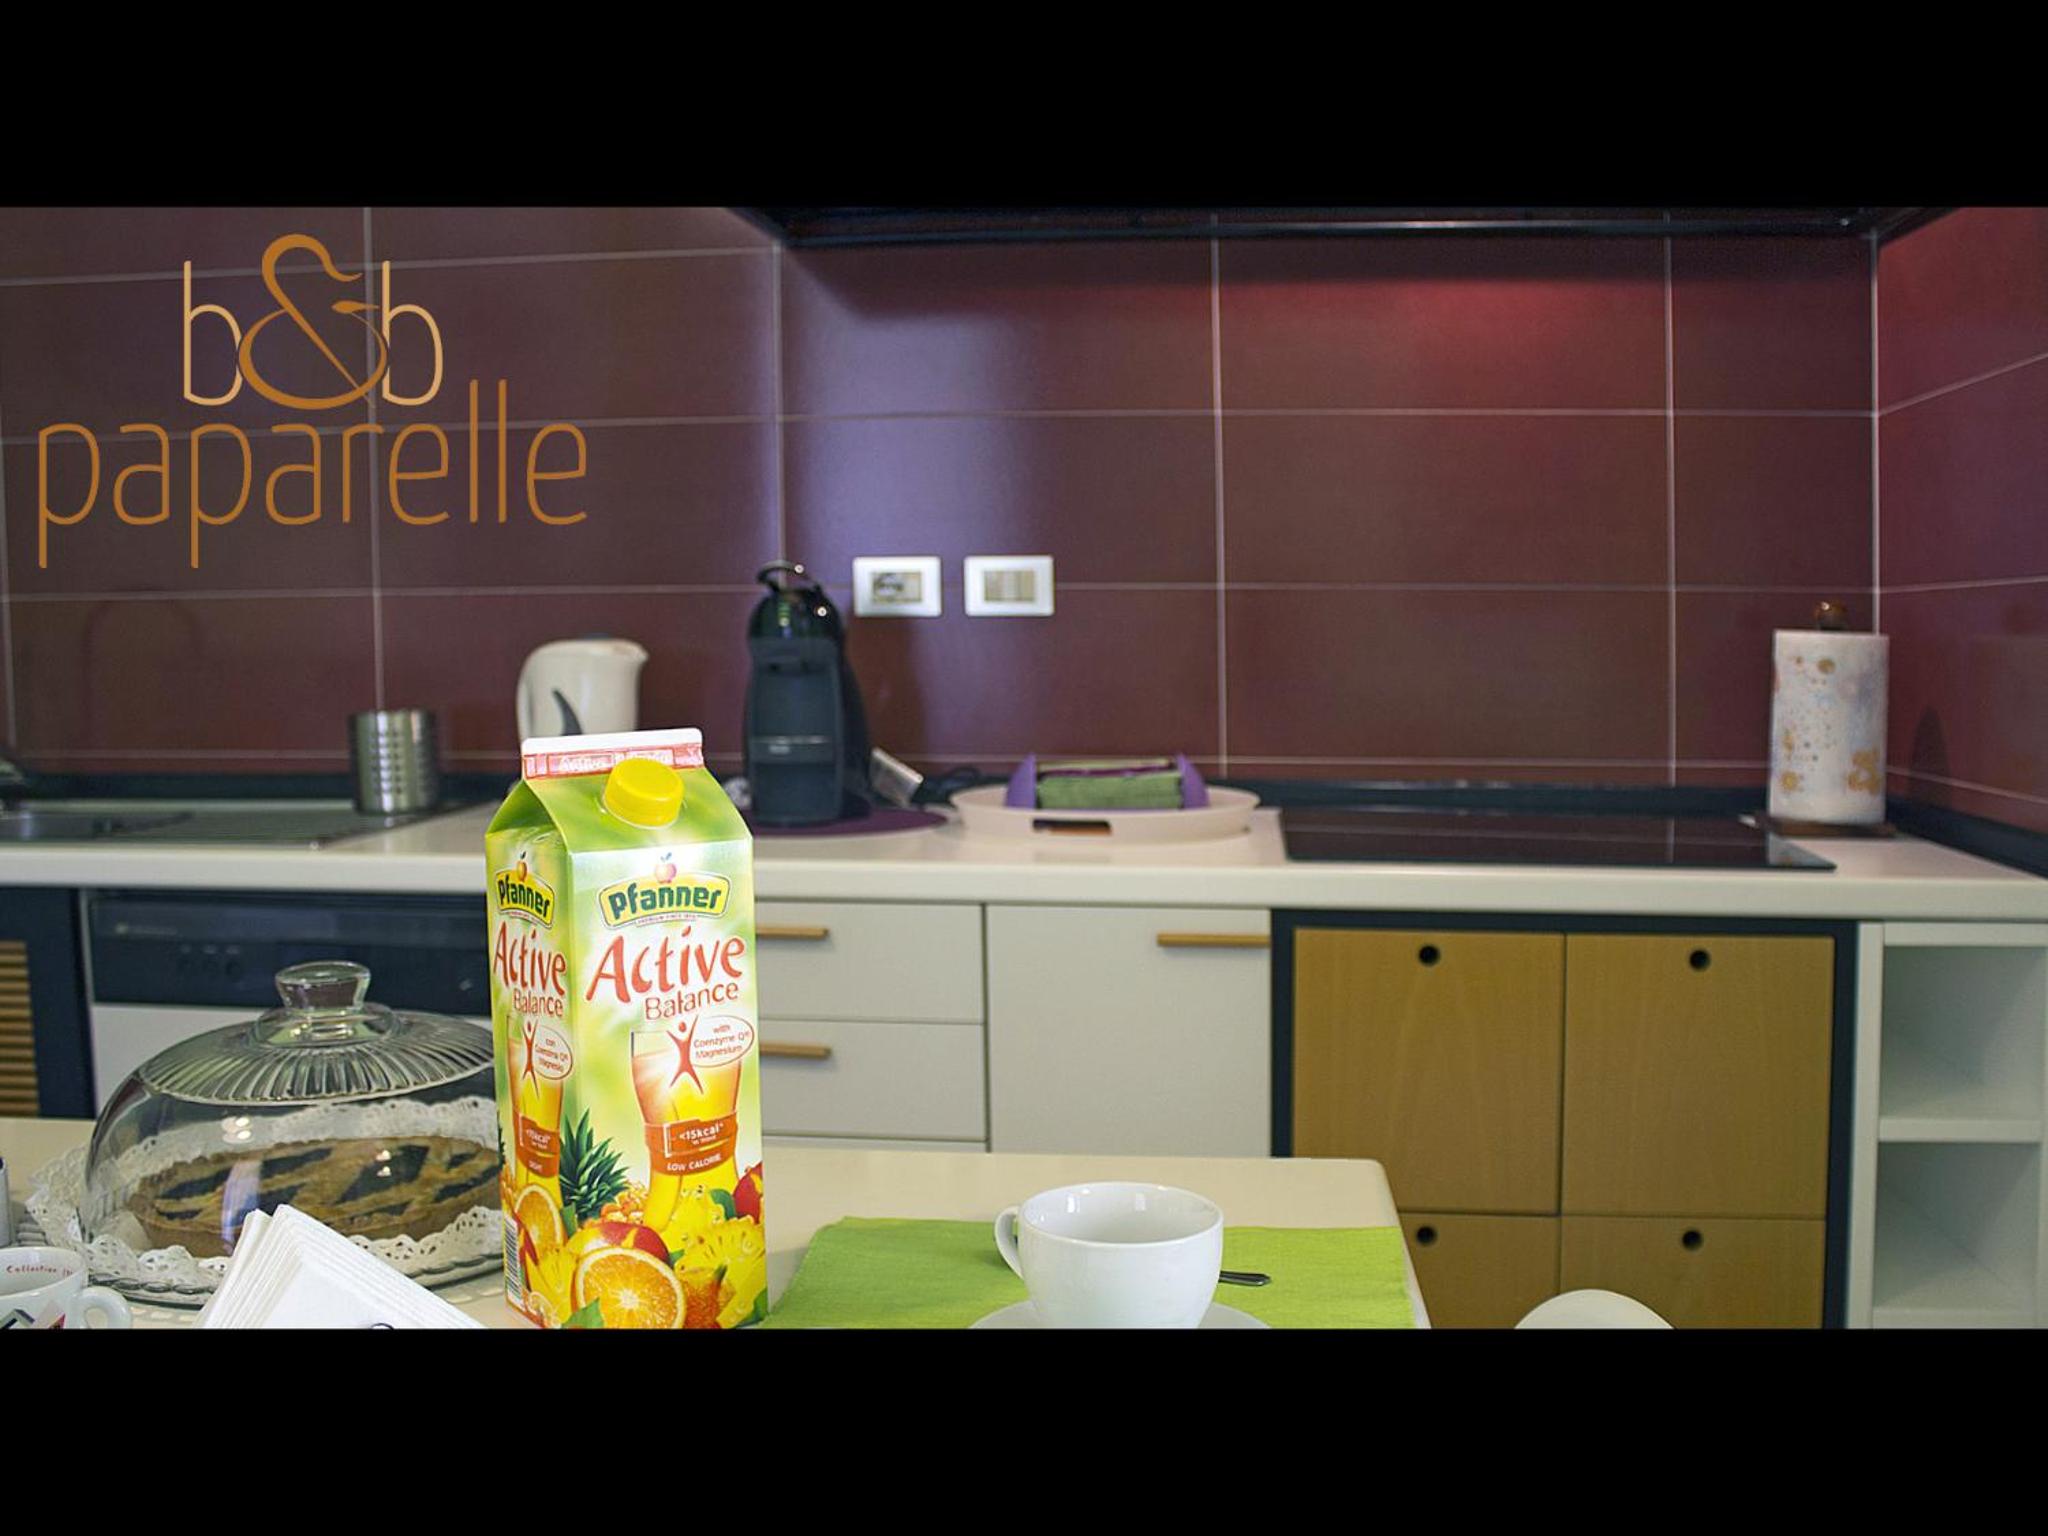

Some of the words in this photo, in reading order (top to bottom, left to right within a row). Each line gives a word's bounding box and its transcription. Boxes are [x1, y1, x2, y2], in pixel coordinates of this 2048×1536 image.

[494, 922, 566, 996] Active
[586, 926, 745, 1003] Active
[513, 989, 563, 1017] Balance
[645, 982, 739, 1020] Balance
[667, 1162, 686, 1171] LOW
[688, 1153, 721, 1170] CALORIE
